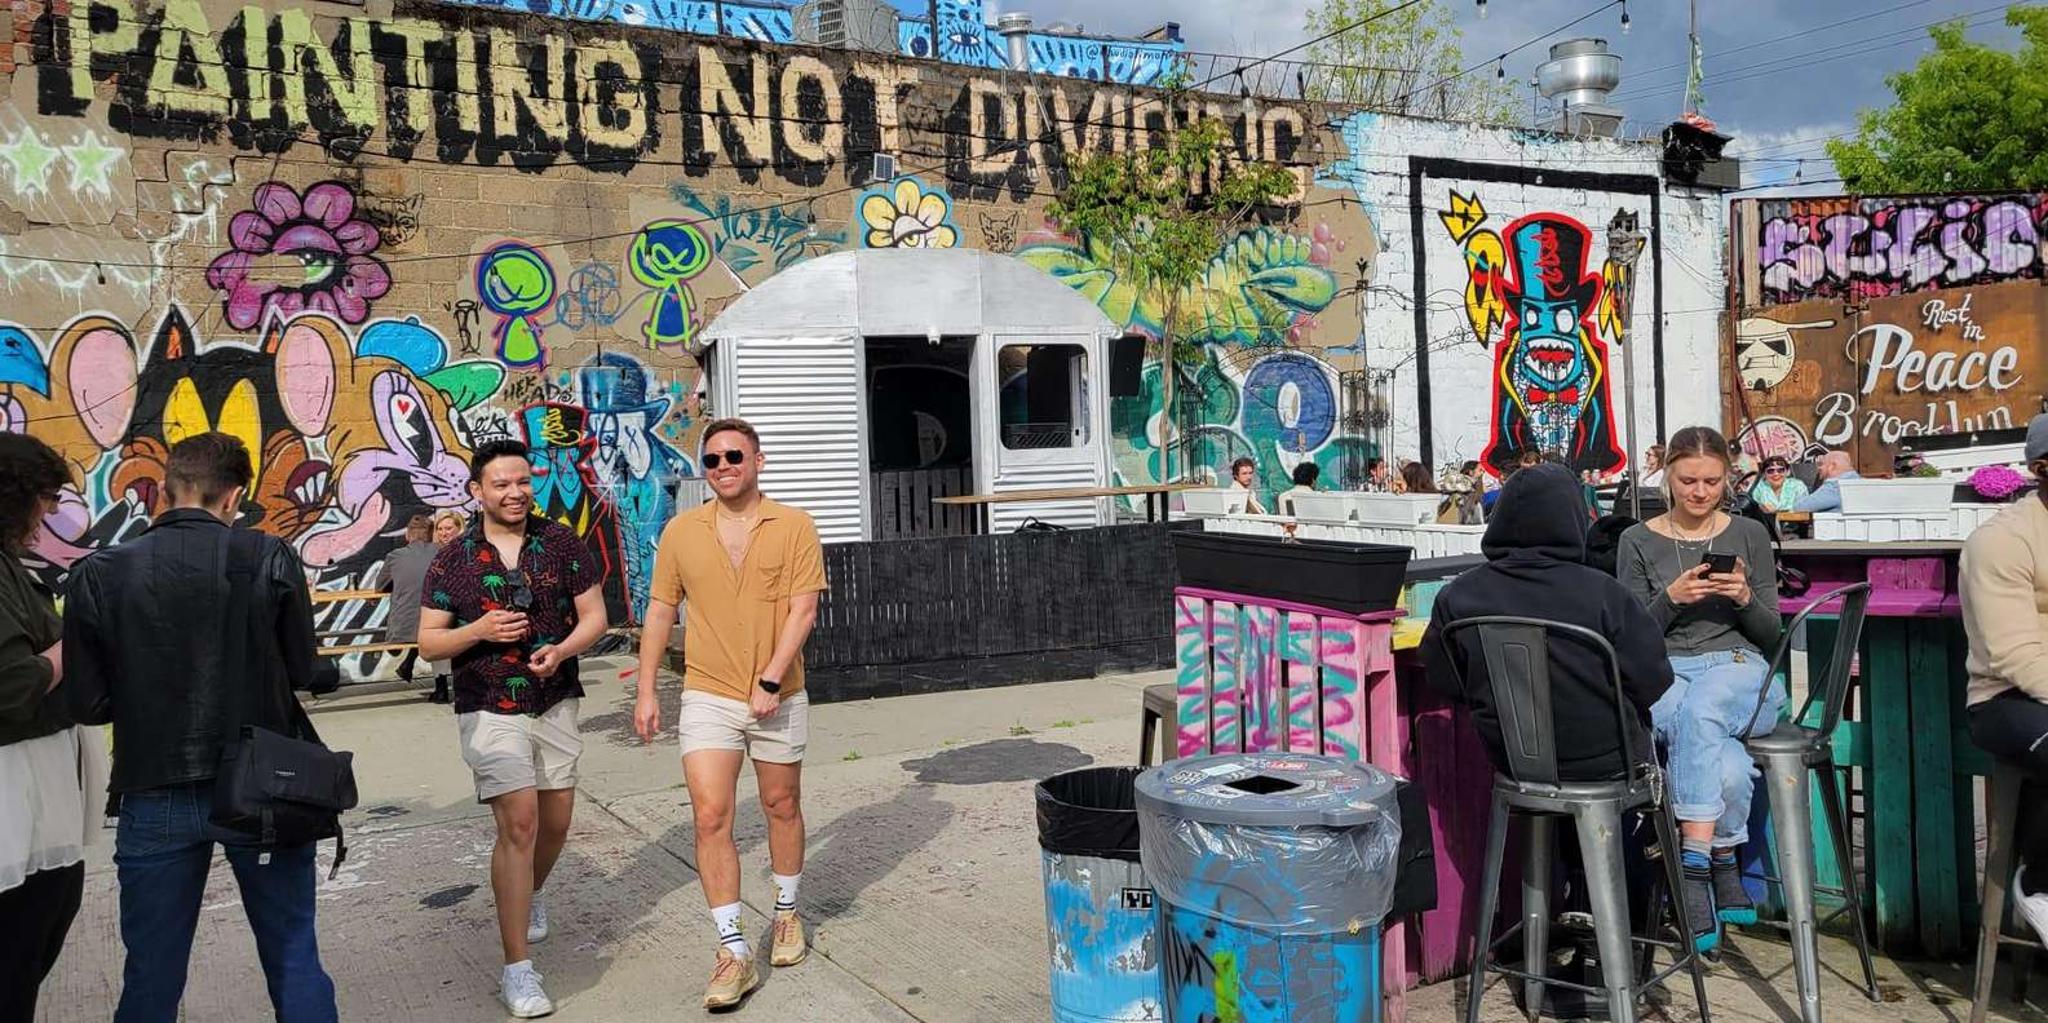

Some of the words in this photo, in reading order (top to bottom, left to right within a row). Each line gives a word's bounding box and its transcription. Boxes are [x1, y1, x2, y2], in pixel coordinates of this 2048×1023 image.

[58, 0, 652, 156] PAINTING
[695, 44, 918, 170] NOT
[1922, 293, 1973, 325] Rust
[1963, 320, 1985, 341] in
[1846, 323, 2023, 394] Peace
